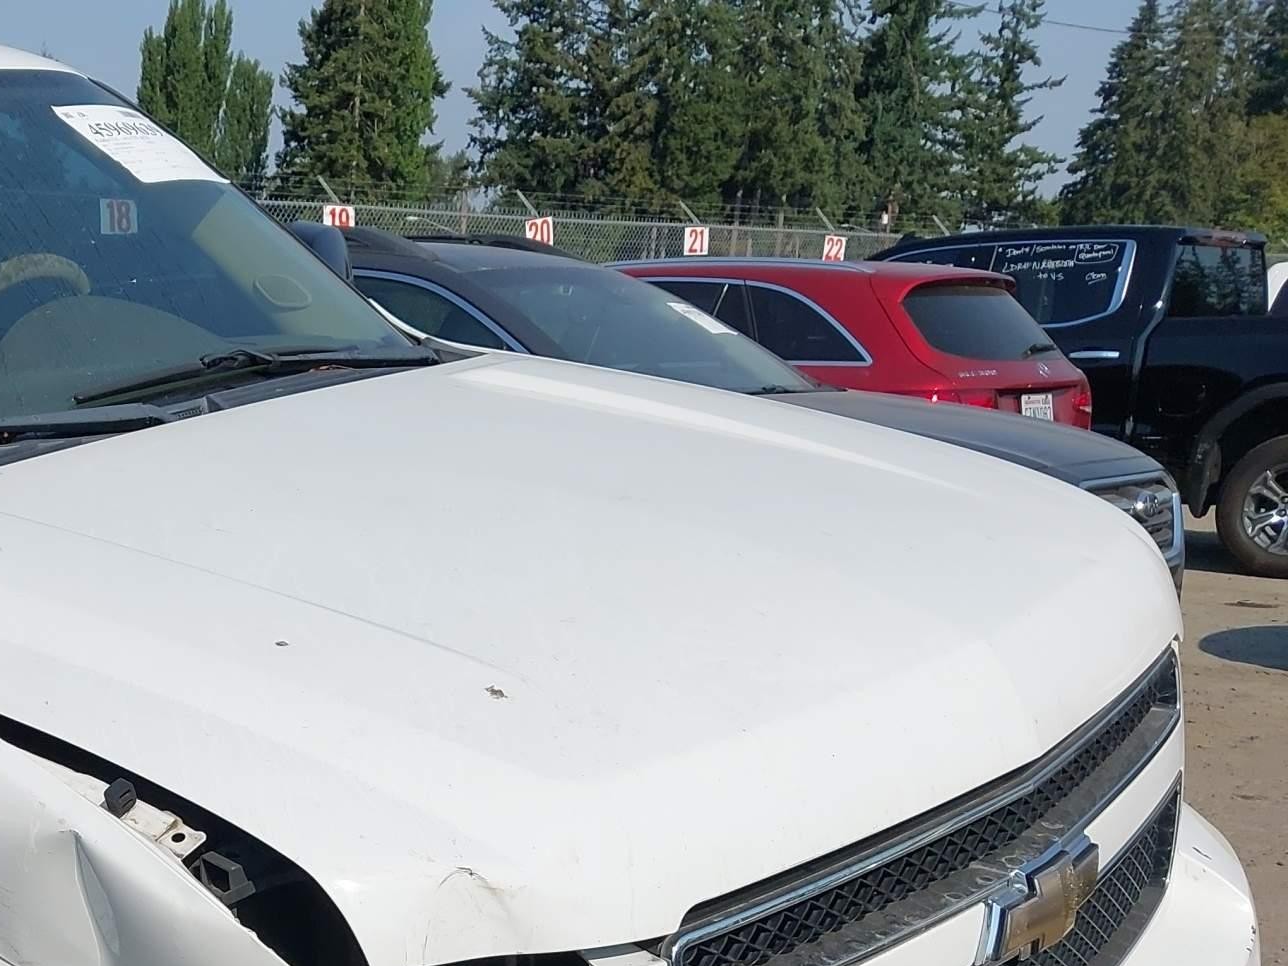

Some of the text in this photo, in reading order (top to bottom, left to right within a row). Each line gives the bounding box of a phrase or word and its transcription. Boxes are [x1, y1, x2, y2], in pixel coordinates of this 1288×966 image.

[88, 121, 164, 137] 45969639
[106, 200, 131, 232] 18
[528, 219, 550, 243] 20
[688, 229, 705, 253] 21
[824, 238, 843, 262] 22
